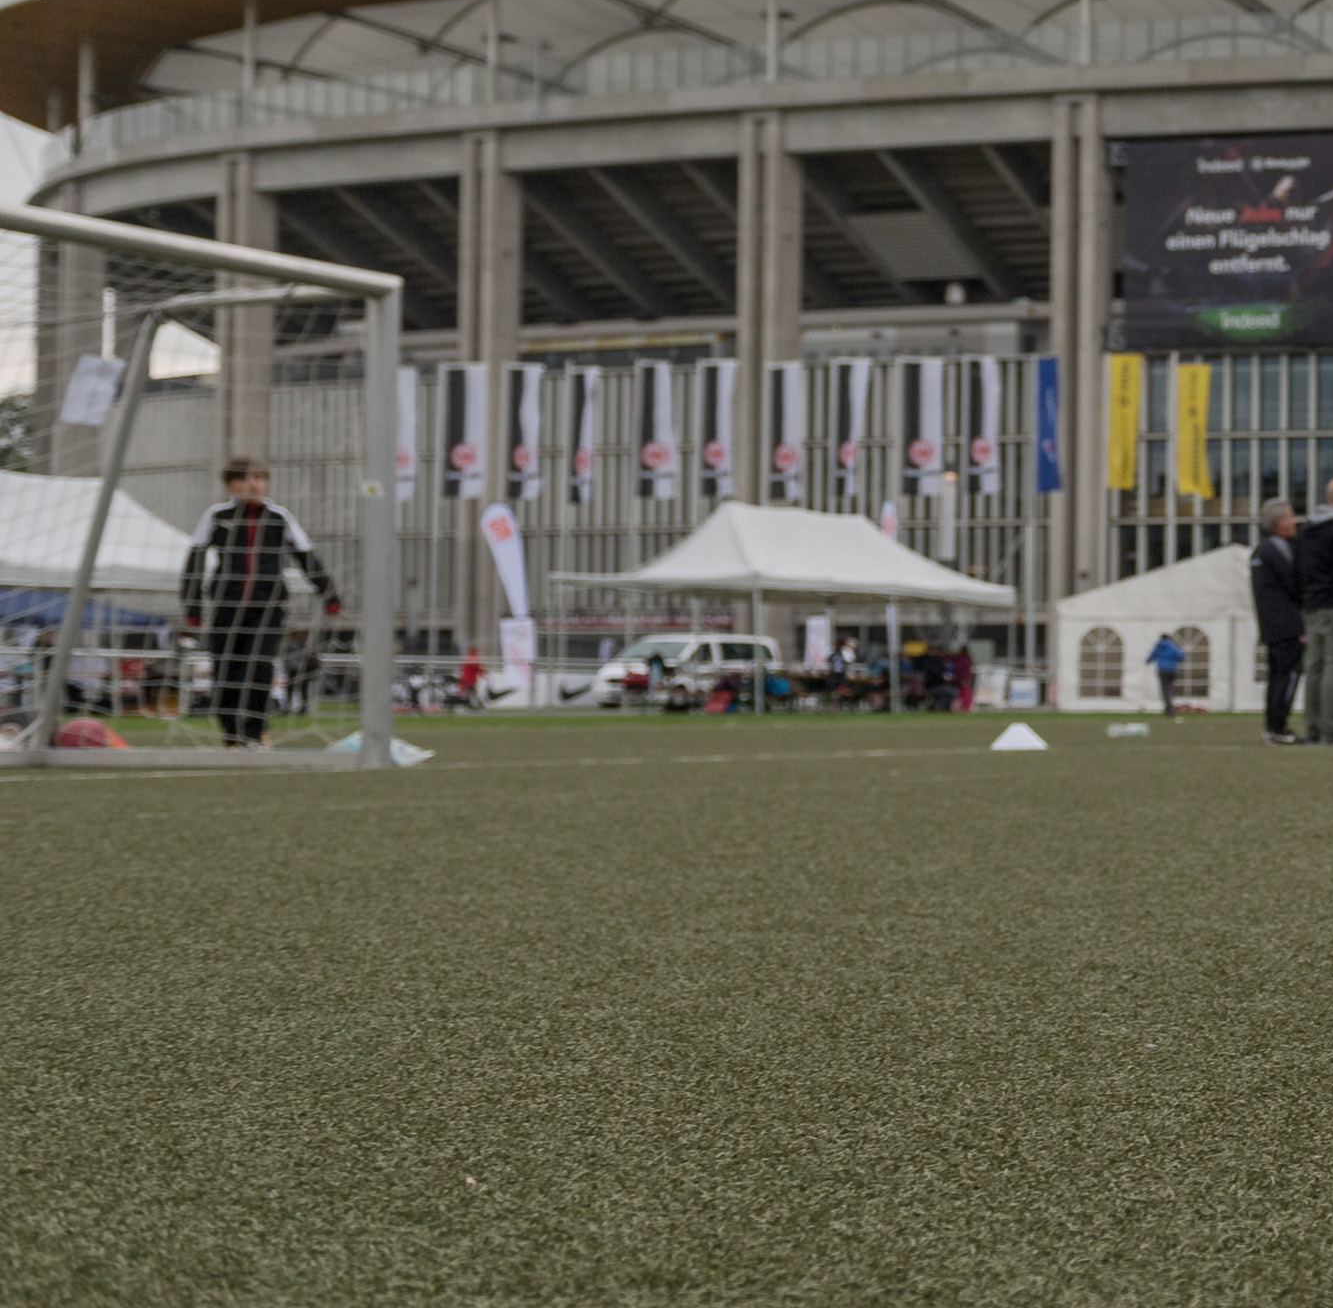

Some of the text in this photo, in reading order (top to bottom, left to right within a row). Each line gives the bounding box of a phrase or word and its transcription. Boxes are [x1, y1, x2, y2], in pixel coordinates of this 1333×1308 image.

[1185, 205, 1236, 225] Neue
[1284, 205, 1318, 221] nur
[1165, 227, 1331, 252] einen Flügelschlag
